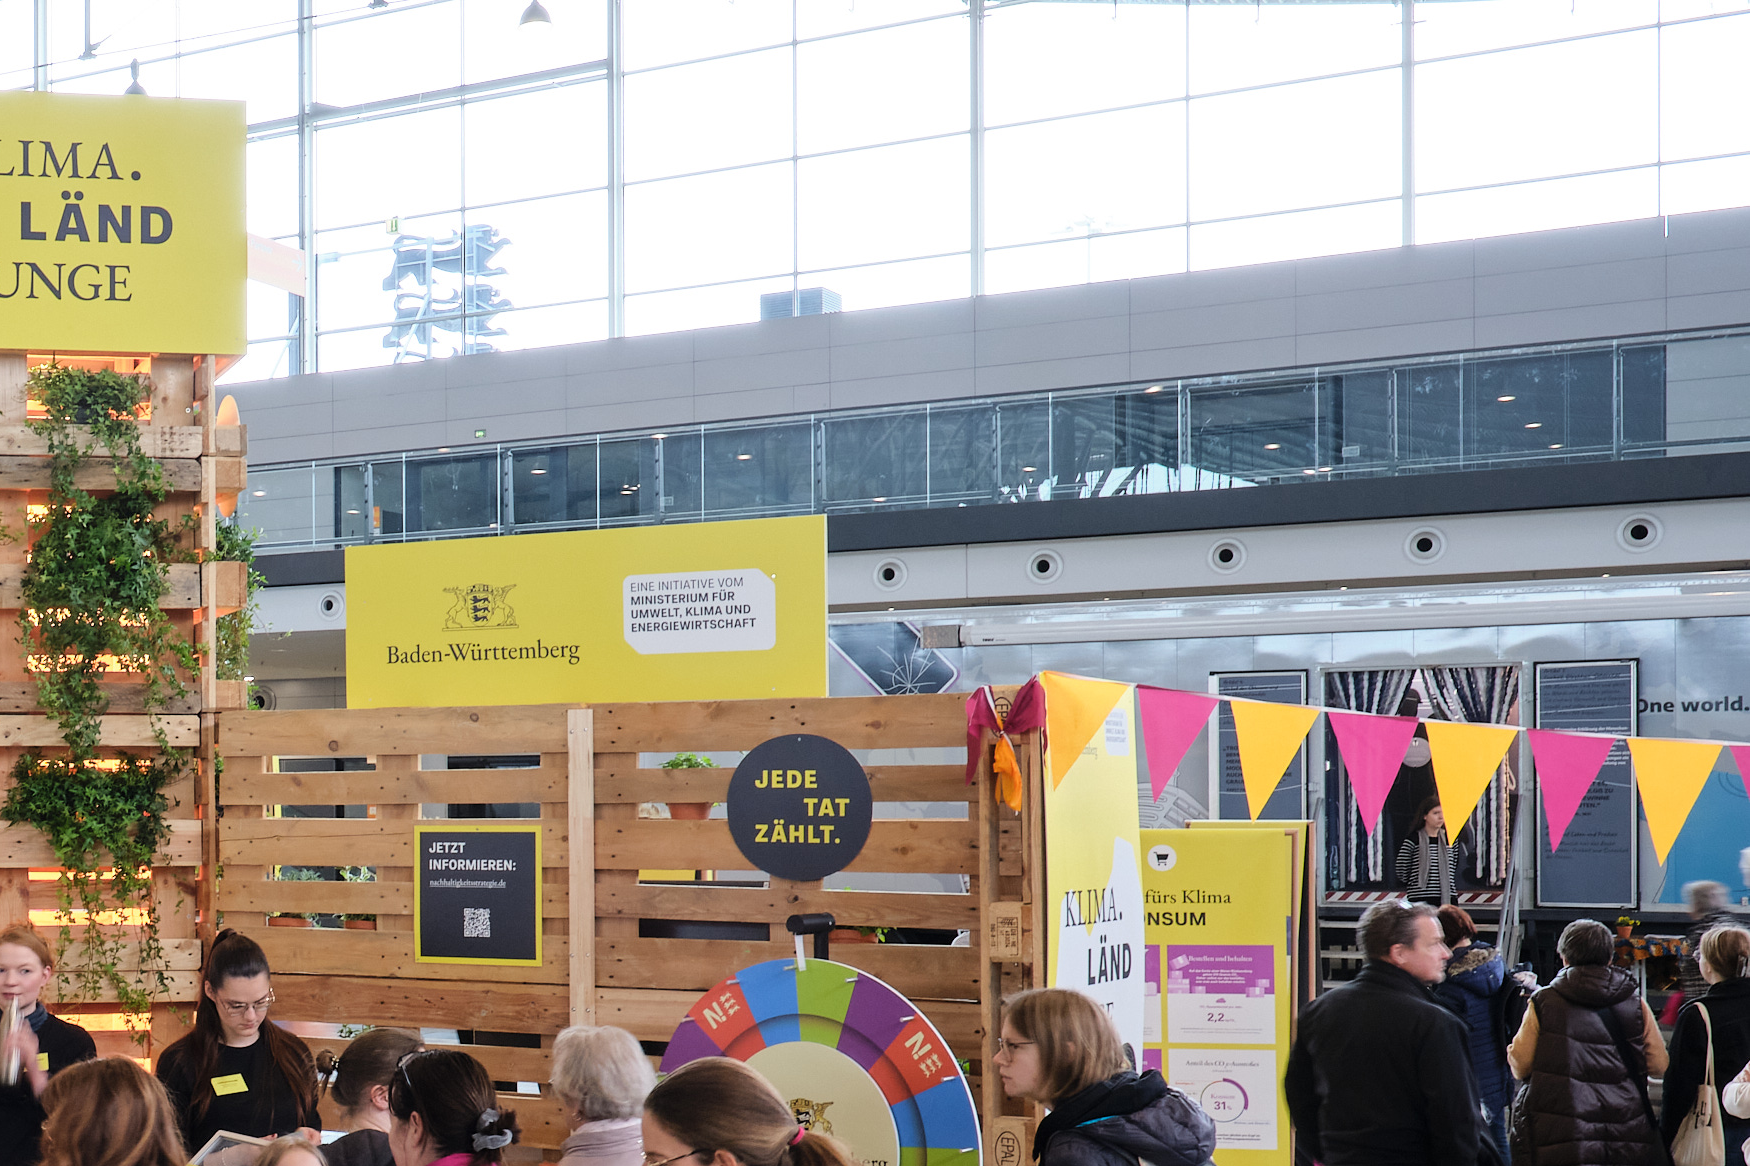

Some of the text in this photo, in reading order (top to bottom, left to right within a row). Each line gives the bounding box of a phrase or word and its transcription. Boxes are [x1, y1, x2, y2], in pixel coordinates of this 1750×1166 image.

[21, 190, 173, 244] LÄND
[630, 577, 744, 592] EINE INITIATIVE VOM
[630, 589, 735, 606] MINISTERIUM FÜR
[631, 604, 751, 619] UMWELT, KLIMA UND
[631, 618, 757, 632] ENERGIEWIRTSCHAFT
[387, 639, 581, 665] Baden-Württemberg
[1638, 696, 1750, 713] One world.
[754, 770, 817, 789] JEDE
[803, 798, 850, 817] TAT
[754, 818, 841, 844] ZÄHLT.
[429, 842, 466, 854] JETZT
[429, 858, 517, 871] INFORMIEREN:
[1145, 889, 1232, 905] fürs Klima
[1065, 886, 1123, 928] KLIMA.
[1144, 912, 1207, 926] NSUM
[1087, 934, 1132, 986] LÄND
[1207, 1012, 1225, 1023] 2,2
[1000, 1136, 1015, 1166] EPAL
